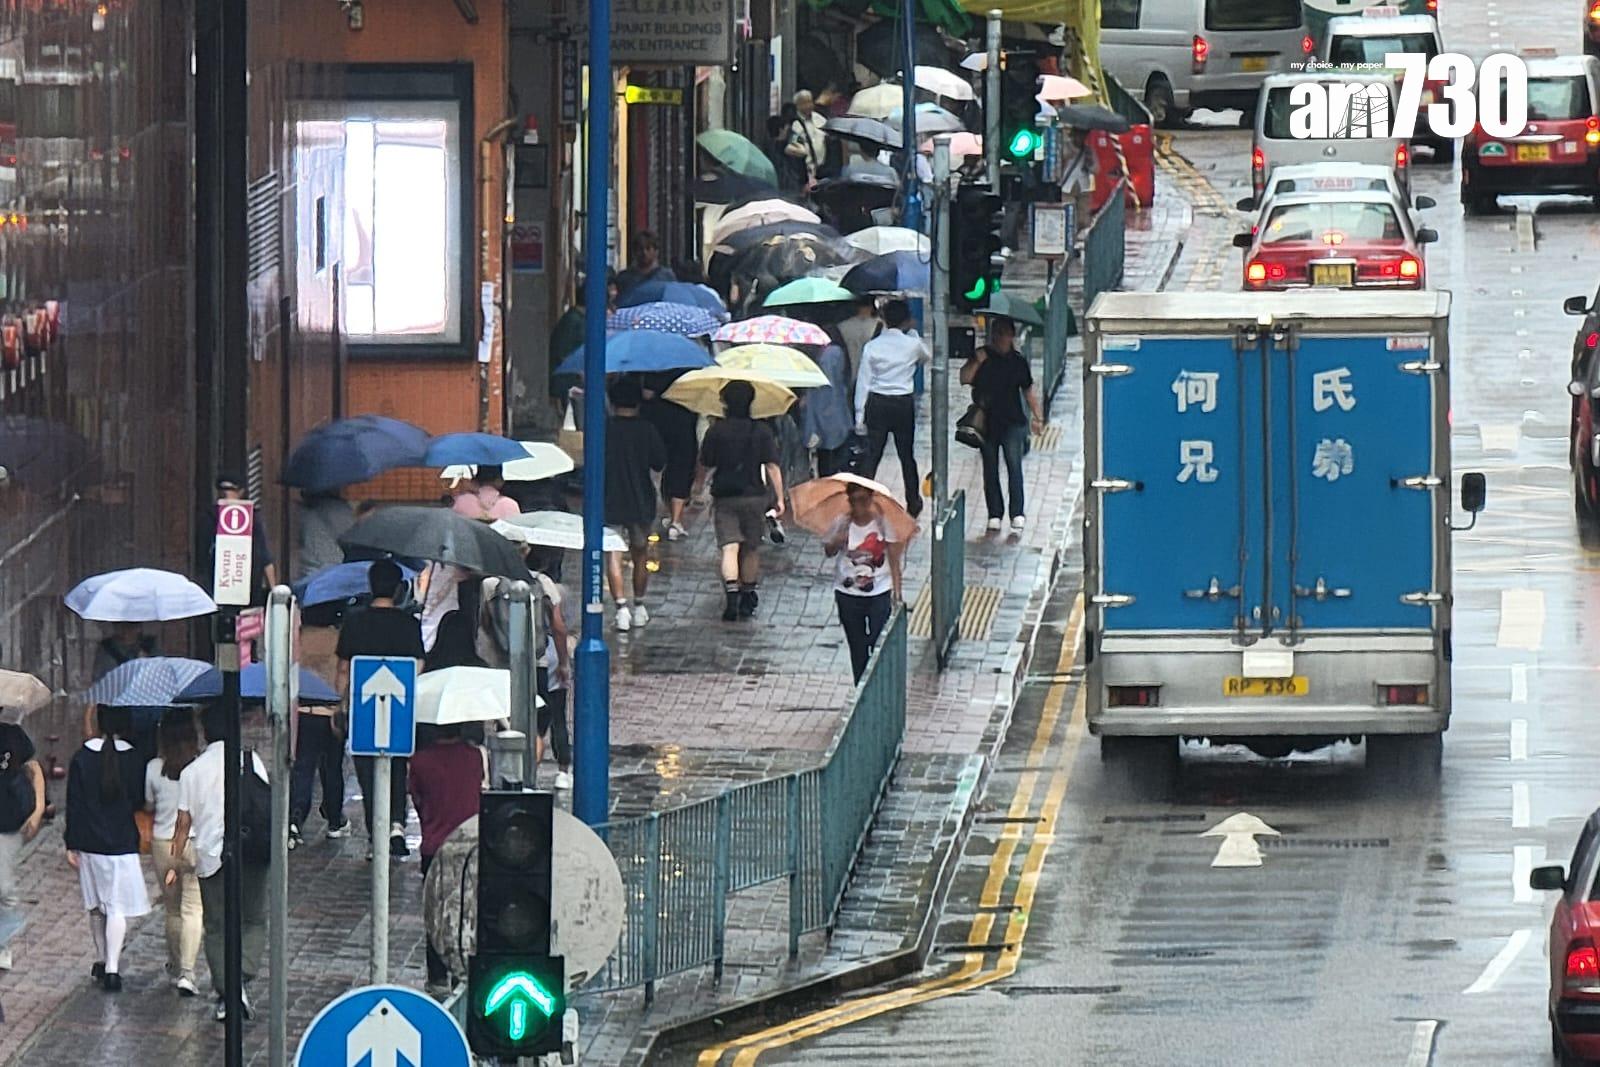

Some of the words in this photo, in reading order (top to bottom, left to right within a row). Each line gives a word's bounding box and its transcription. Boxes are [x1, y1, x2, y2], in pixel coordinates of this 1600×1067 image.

[616, 22, 650, 34] PAINT
[654, 22, 722, 34] BUILDINGS
[609, 38, 636, 50] ARK
[639, 38, 708, 51] ENTRANCE
[219, 551, 231, 587] Kwun
[232, 554, 247, 585] Tong
[1228, 679, 1250, 694] RP
